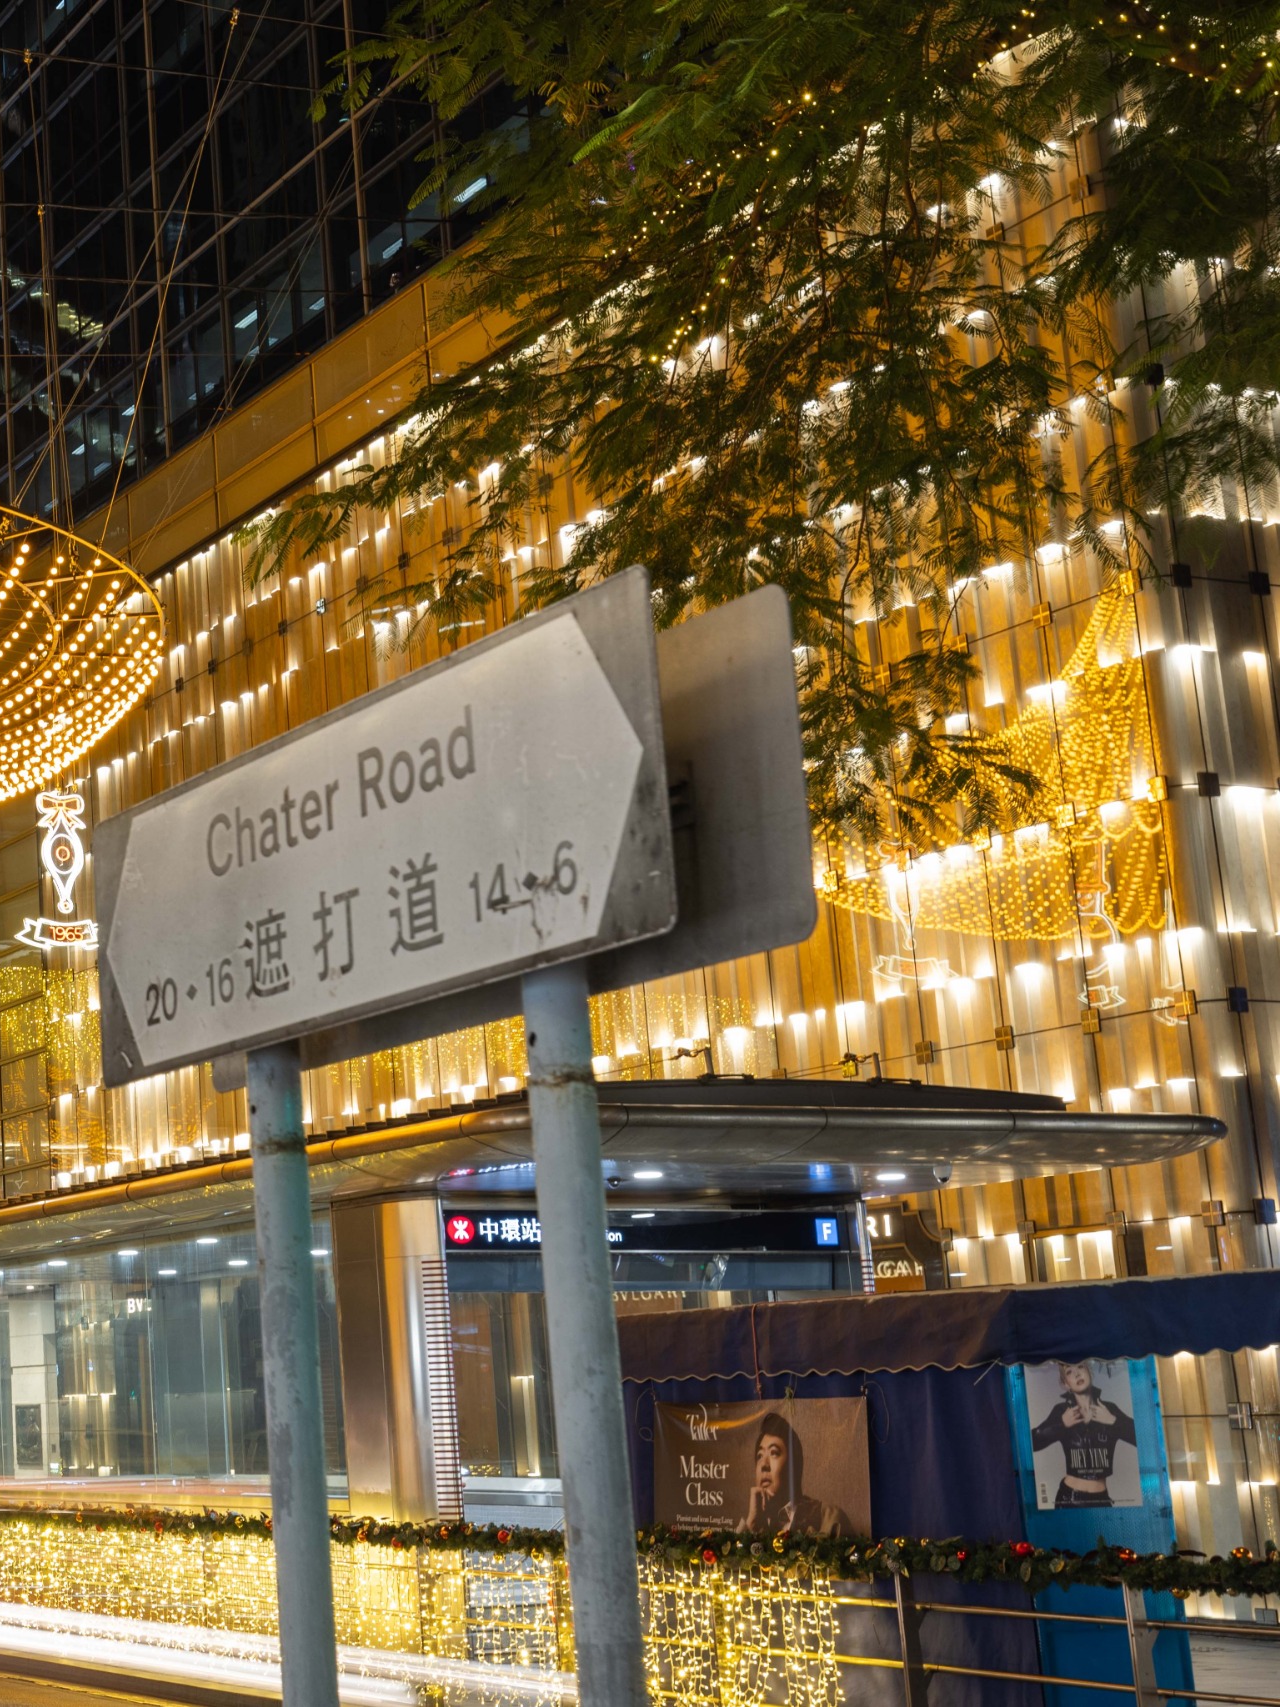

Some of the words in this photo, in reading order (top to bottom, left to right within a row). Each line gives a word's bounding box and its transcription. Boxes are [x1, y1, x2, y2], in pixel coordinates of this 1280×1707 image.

[205, 780, 340, 877] Chater
[357, 705, 477, 819] Road
[49, 926, 84, 942] 1965
[145, 979, 177, 1027] 20
[206, 957, 235, 1007] 16
[244, 852, 444, 1000] 遮打道
[467, 862, 508, 923] 14
[552, 839, 578, 896] 6
[478, 1217, 543, 1243] 中環站
[822, 1222, 832, 1241] F
[680, 1455, 730, 1479] Master
[1088, 1447, 1110, 1468] YUNG
[685, 1482, 724, 1506] Class
[709, 1515, 721, 1525] Lang
[721, 1516, 733, 1526] Lang
